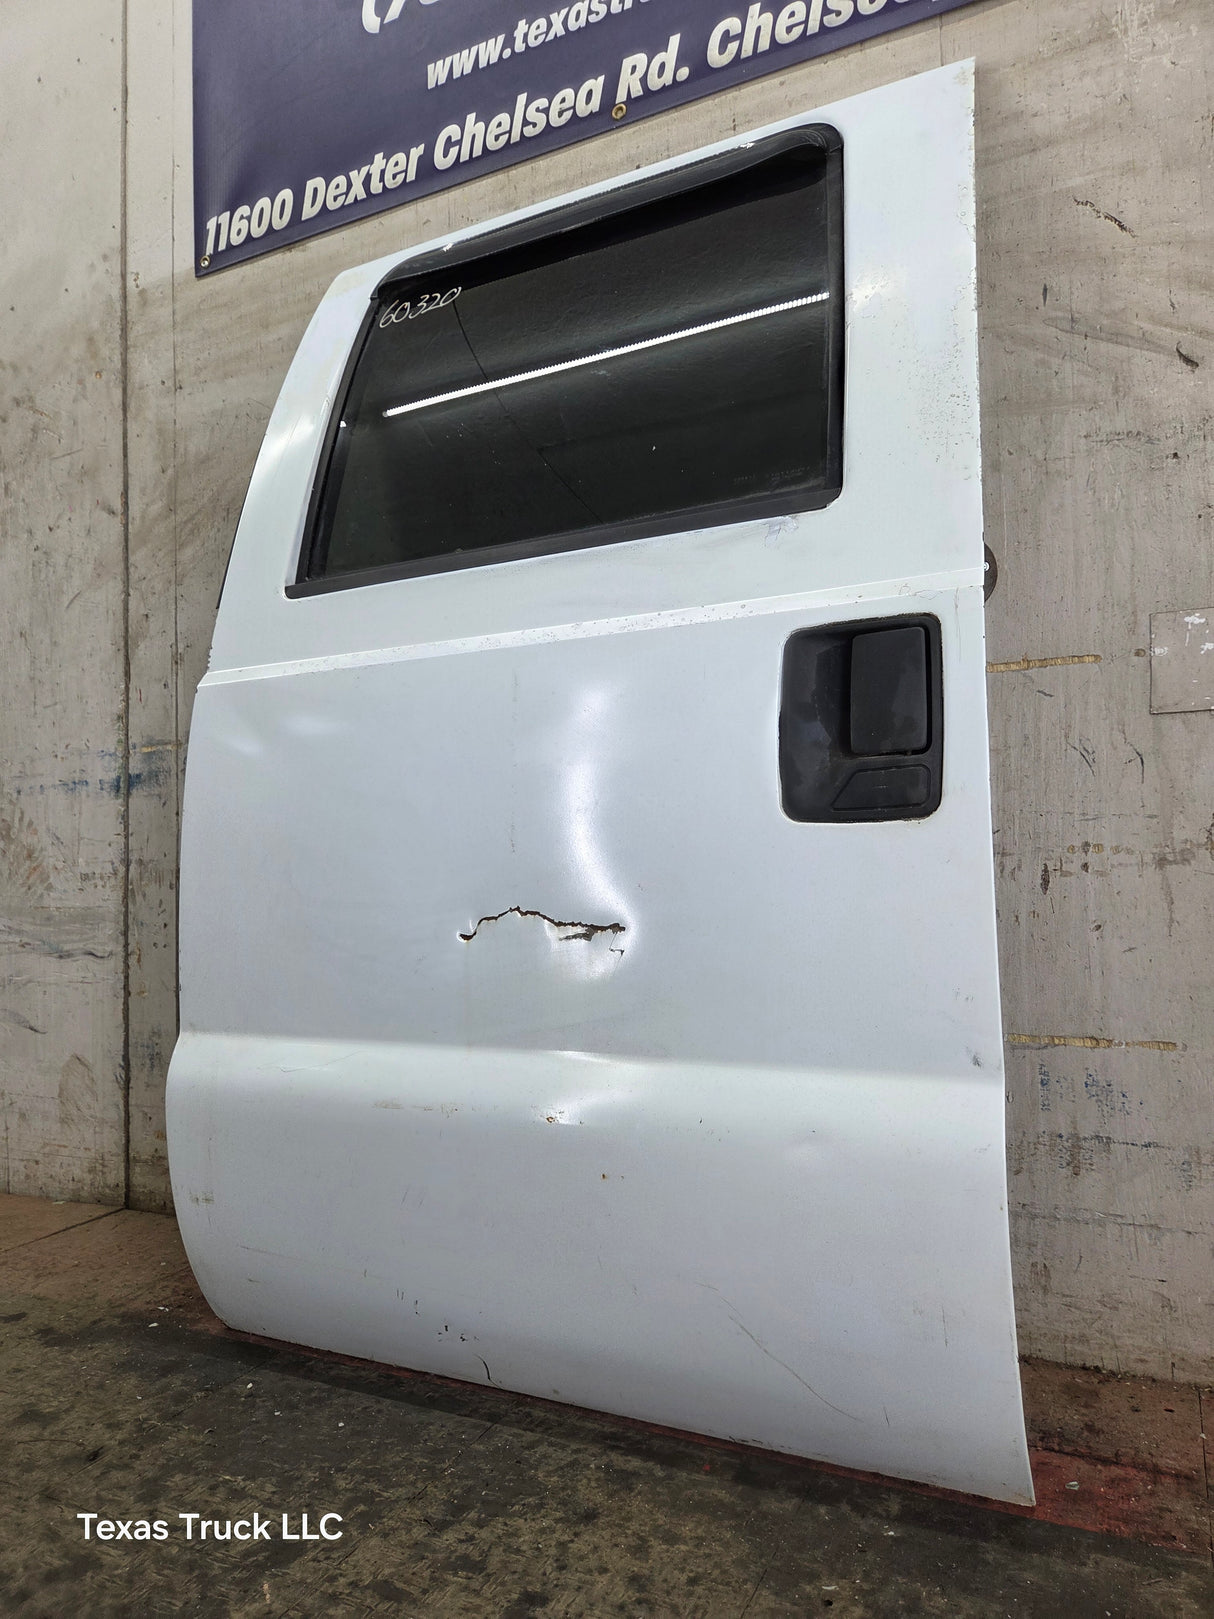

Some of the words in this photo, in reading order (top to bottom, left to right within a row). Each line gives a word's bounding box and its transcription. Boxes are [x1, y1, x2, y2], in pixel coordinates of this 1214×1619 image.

[427, 0, 649, 89] www.texas
[205, 188, 293, 255] 11600
[301, 143, 425, 221] Dexter
[433, 76, 605, 170] Chelsea
[616, 34, 690, 104] Rd.
[707, 0, 911, 68] Chels
[380, 286, 462, 328] 60320
